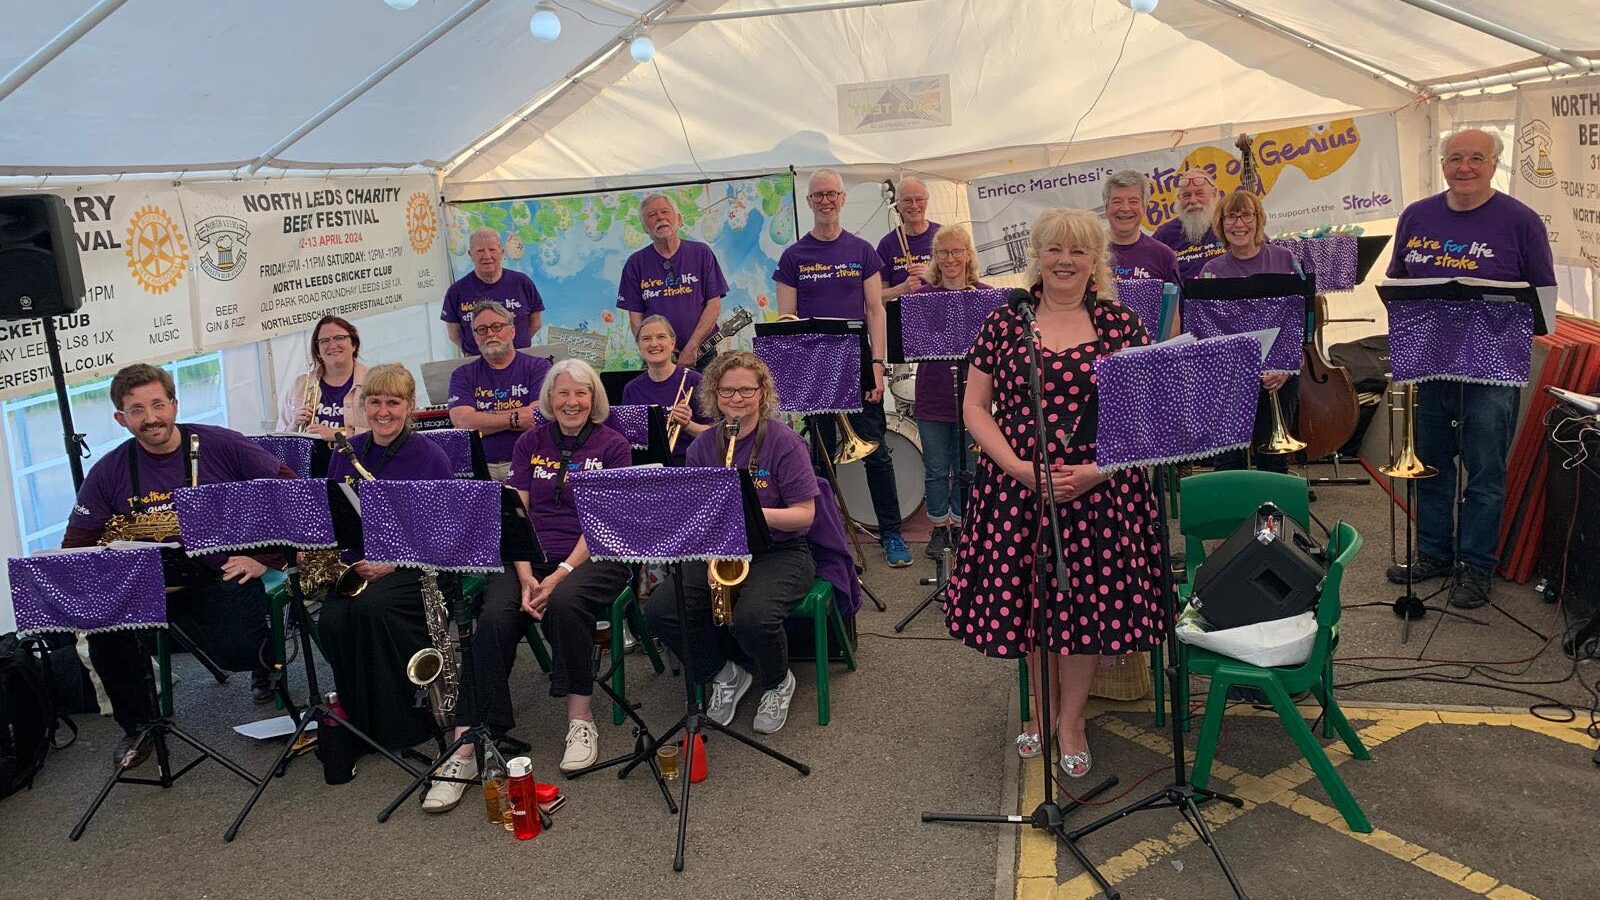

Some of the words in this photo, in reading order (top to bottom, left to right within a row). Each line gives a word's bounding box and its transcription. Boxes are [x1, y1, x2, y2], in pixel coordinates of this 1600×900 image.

[1552, 93, 1600, 116] NORTH
[1579, 124, 1600, 146] BE
[1258, 127, 1357, 166] Genius
[978, 182, 1026, 199] Enrico
[243, 192, 302, 212] NORTH
[305, 189, 342, 208] LEEDS
[346, 187, 401, 204] CHARITY
[1342, 191, 1392, 210] Stroke
[1278, 207, 1310, 220] support
[1321, 204, 1335, 212] the
[283, 214, 312, 234] BEER
[316, 208, 380, 228] FESTIVAL
[320, 232, 342, 246] APRIL
[345, 232, 363, 244] 2024
[1444, 239, 1468, 252] for
[1468, 241, 1494, 258] life
[326, 251, 366, 266] SATURDAY:
[1434, 252, 1479, 270] stroke
[799, 262, 832, 272] Together
[799, 272, 834, 282] conquer
[836, 268, 860, 278] stroke
[1134, 266, 1150, 278] life
[272, 279, 302, 294] NORTH
[304, 274, 334, 288] LEEDS
[335, 268, 372, 282] CRICKET
[374, 266, 392, 276] CLUB
[681, 272, 698, 284] life
[260, 300, 274, 312] OLD
[276, 296, 296, 309] PARK
[298, 292, 320, 305] ROAD
[320, 286, 358, 300] ROUNDHAY
[358, 282, 380, 294] LEEDS
[663, 284, 692, 297] stroke
[216, 304, 238, 316] BEER
[506, 298, 522, 310] life
[154, 315, 172, 328] LIVE
[206, 322, 222, 332] GIN
[224, 320, 230, 330] &
[232, 316, 246, 328] FIZZ
[66, 334, 88, 350] LS8
[93, 330, 114, 344] 1JX
[149, 329, 180, 344] MUSIC
[494, 388, 508, 400] for
[512, 384, 529, 397] life
[444, 418, 450, 426] 2
[530, 454, 560, 470] We're
[584, 458, 603, 470] life
[533, 466, 557, 480] fter
